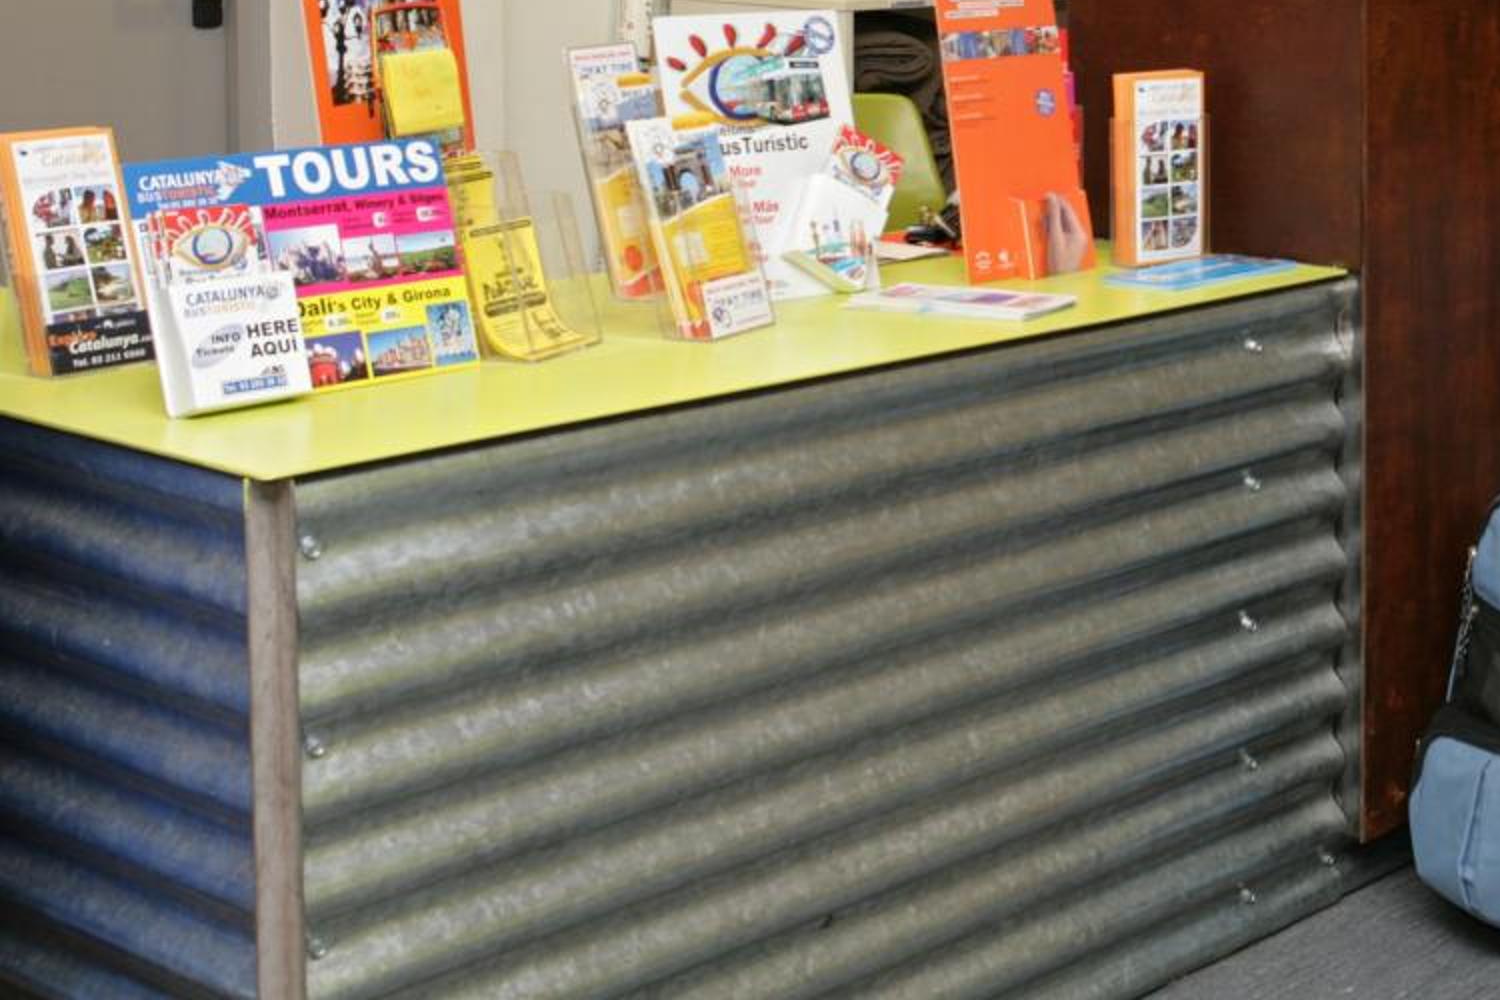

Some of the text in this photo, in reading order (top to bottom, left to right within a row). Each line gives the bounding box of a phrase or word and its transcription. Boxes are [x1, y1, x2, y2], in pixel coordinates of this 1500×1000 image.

[719, 133, 808, 155] usTuristic
[253, 141, 438, 197] TOURS
[185, 285, 265, 306] CATALUNYA
[351, 295, 381, 311] City
[386, 293, 397, 304] &
[402, 287, 451, 303] Girona
[211, 331, 241, 344] INFO
[246, 318, 299, 339] HERE
